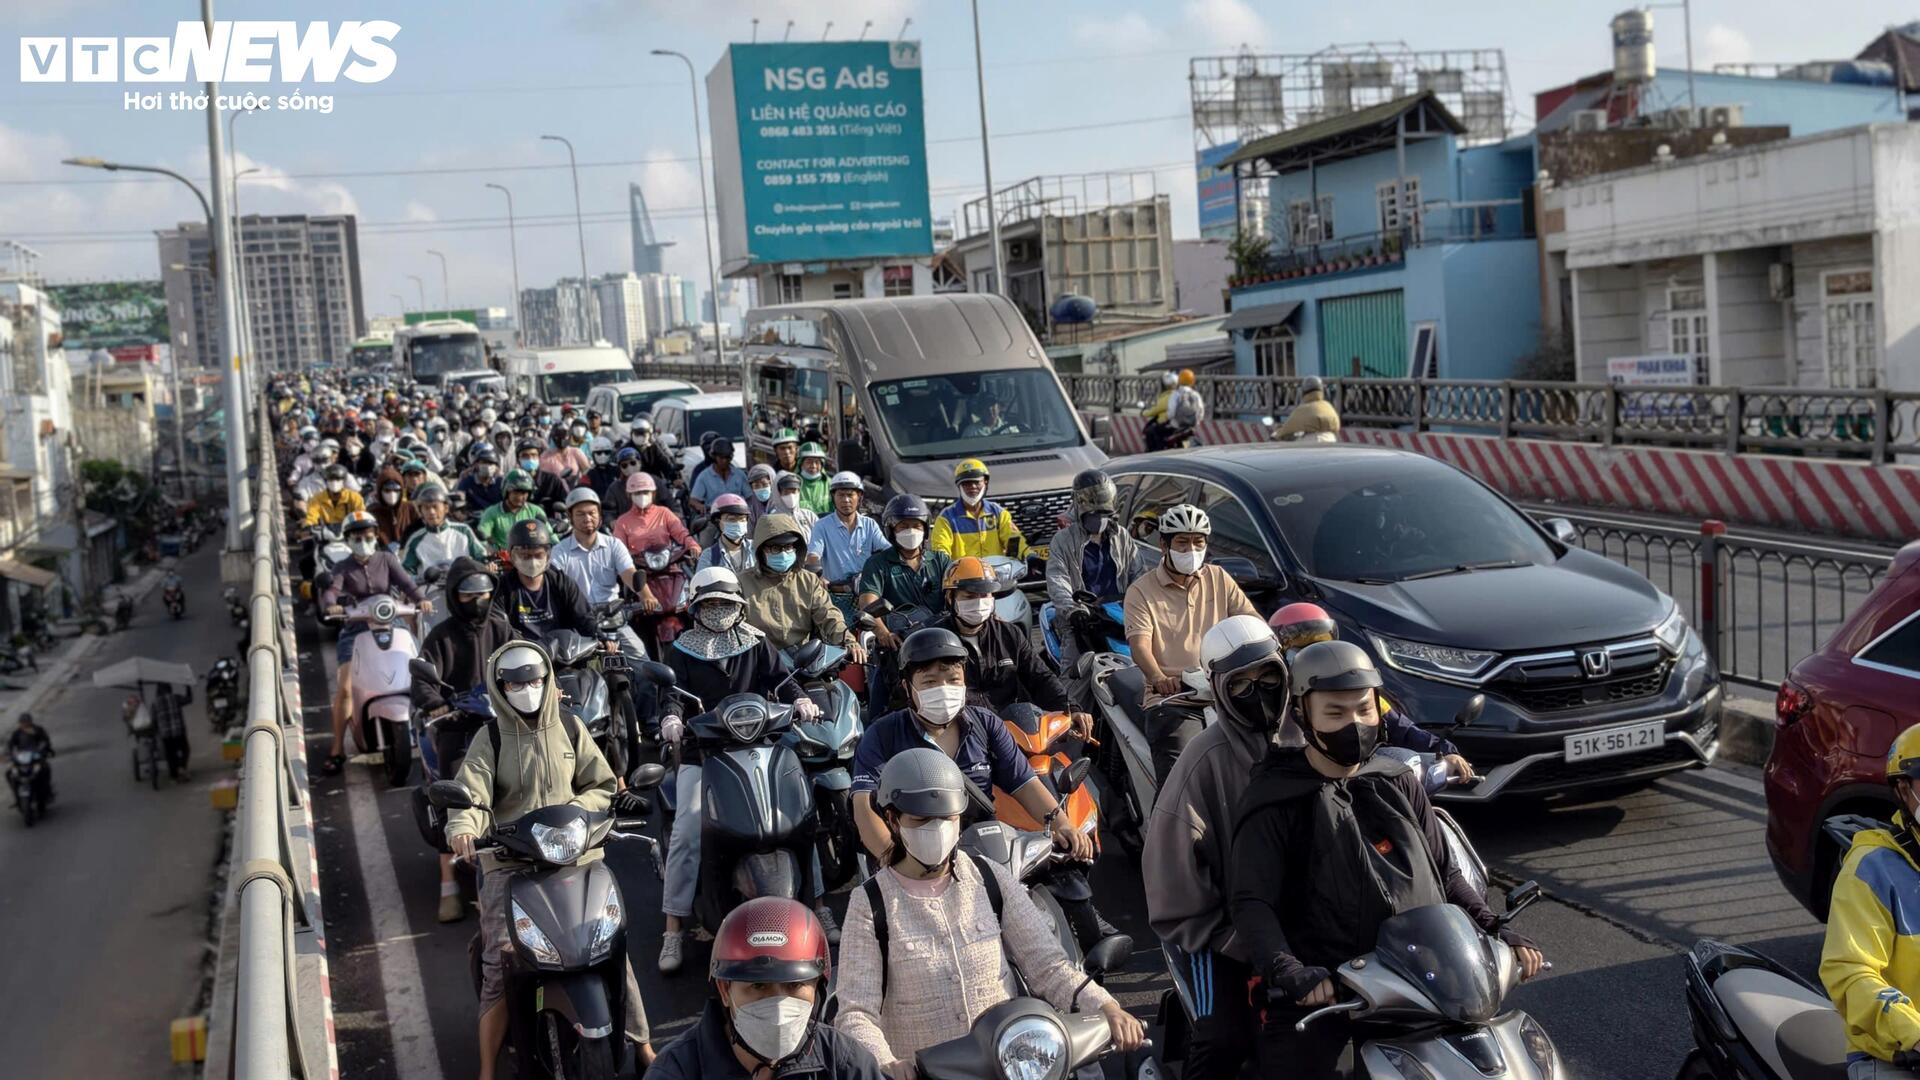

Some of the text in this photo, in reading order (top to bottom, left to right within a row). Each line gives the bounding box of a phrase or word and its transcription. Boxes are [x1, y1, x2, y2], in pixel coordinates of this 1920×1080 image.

[764, 66, 889, 91] NSG Ads
[752, 101, 907, 122] LIÊN HỆ QUẢNG CÁO
[757, 158, 810, 171] CONTACT
[812, 157, 836, 169] FOR
[795, 174, 817, 185] 155
[843, 172, 888, 185] (English)
[754, 223, 794, 236] Chuyên
[796, 222, 814, 235] gia
[815, 220, 849, 234] quảng
[850, 219, 871, 231] cáo
[872, 218, 902, 232] ngoài
[1573, 728, 1655, 756] 51K-561.21
